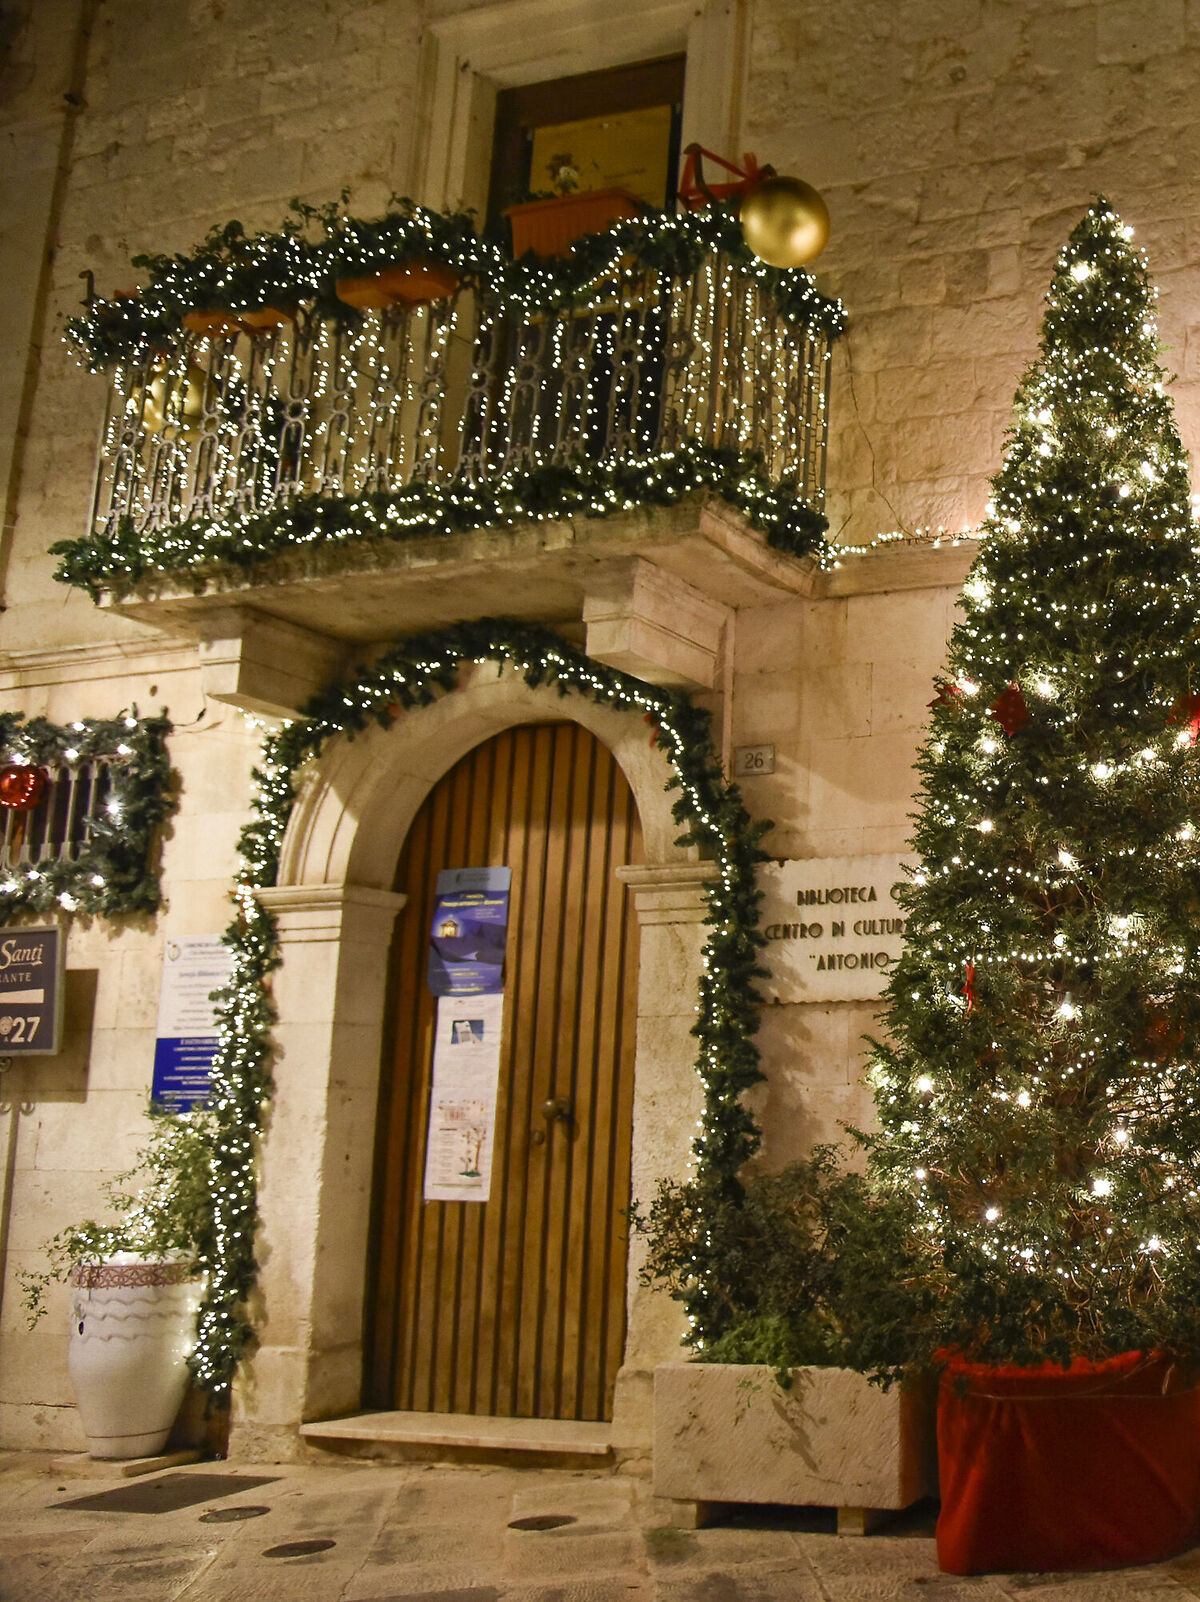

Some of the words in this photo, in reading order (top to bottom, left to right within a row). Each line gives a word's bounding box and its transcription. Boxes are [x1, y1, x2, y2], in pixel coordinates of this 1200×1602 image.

[745, 751, 764, 769] 26
[797, 886, 878, 906] BIBLIOTECA
[765, 922, 824, 940] CENTRO
[832, 921, 846, 937] DI
[853, 918, 907, 936] CULTUR
[0, 940, 44, 970] Santi
[0, 972, 32, 983] ANTE
